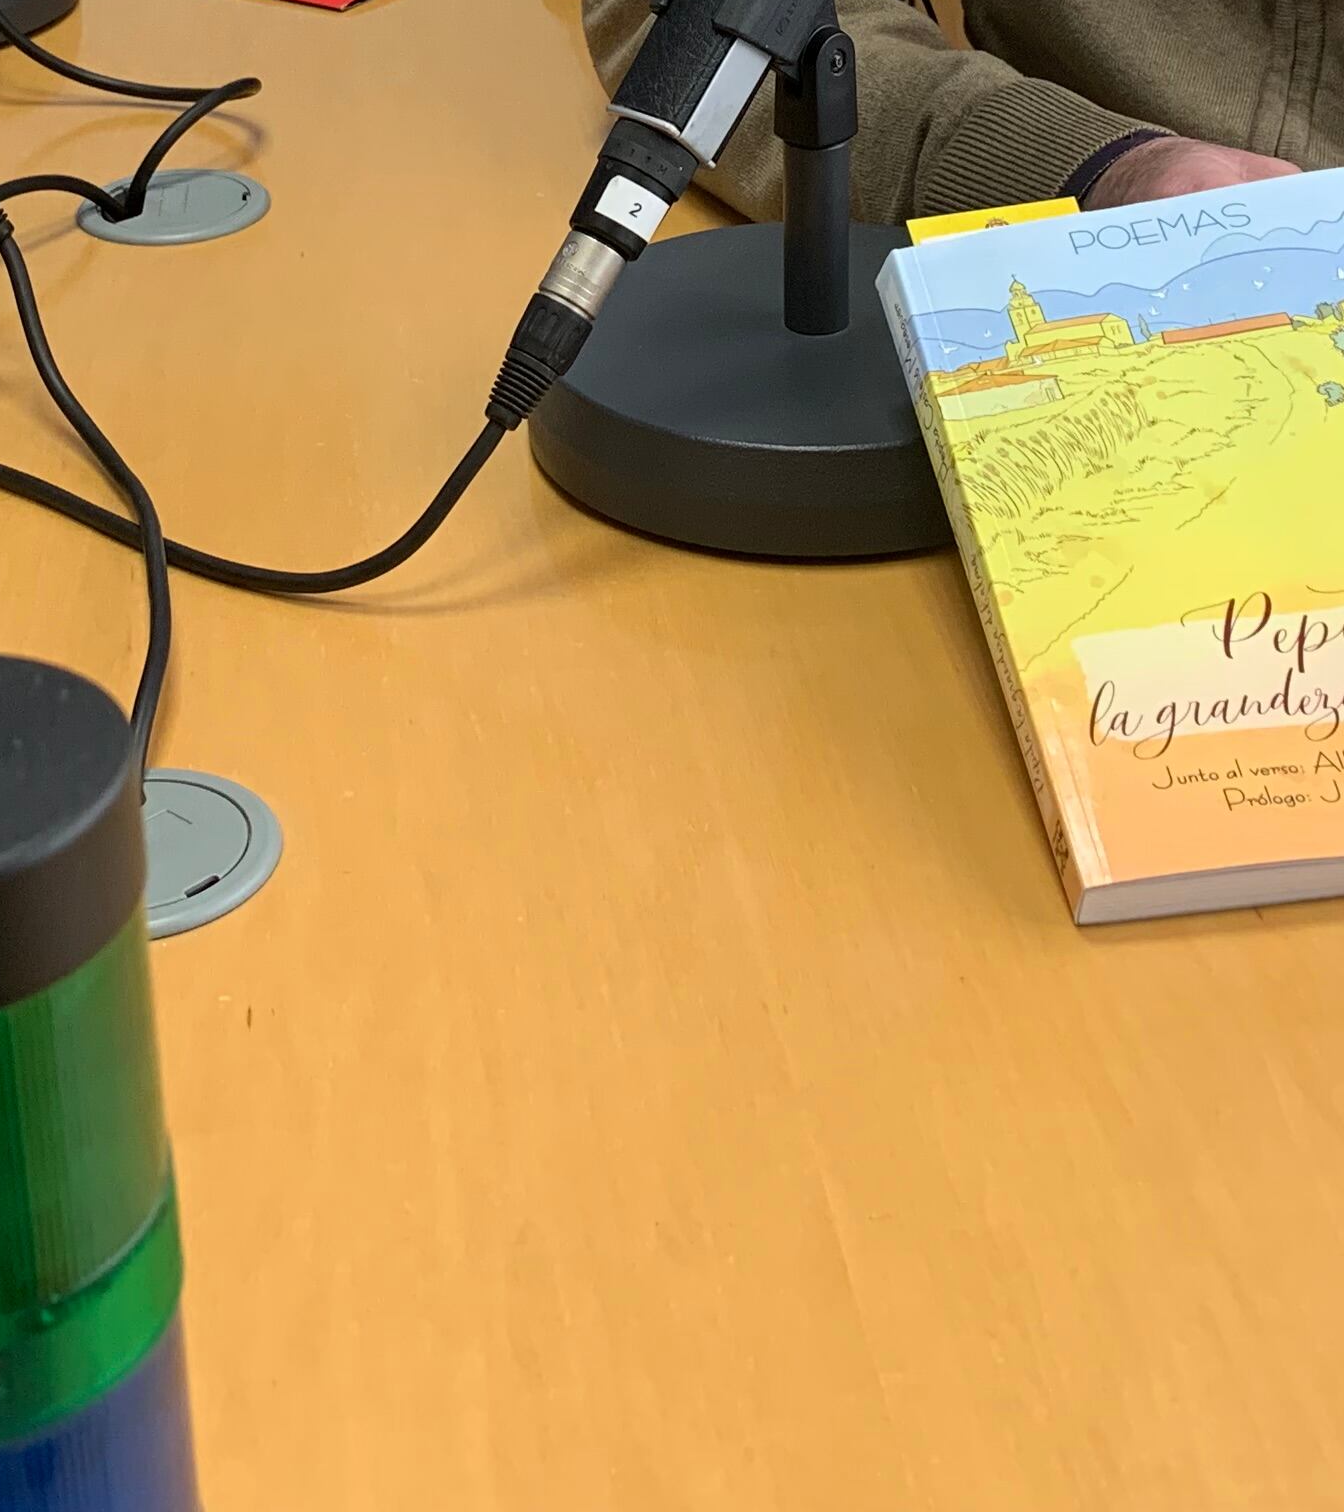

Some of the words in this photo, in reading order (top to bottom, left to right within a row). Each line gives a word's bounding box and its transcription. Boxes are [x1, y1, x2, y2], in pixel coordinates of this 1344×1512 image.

[628, 202, 643, 218] 2
[1068, 202, 1251, 256] POEMAS
[1089, 679, 1144, 747] la
[1152, 765, 1220, 790] Junto
[1225, 758, 1244, 784] al
[1222, 784, 1312, 812] Prólogo:
